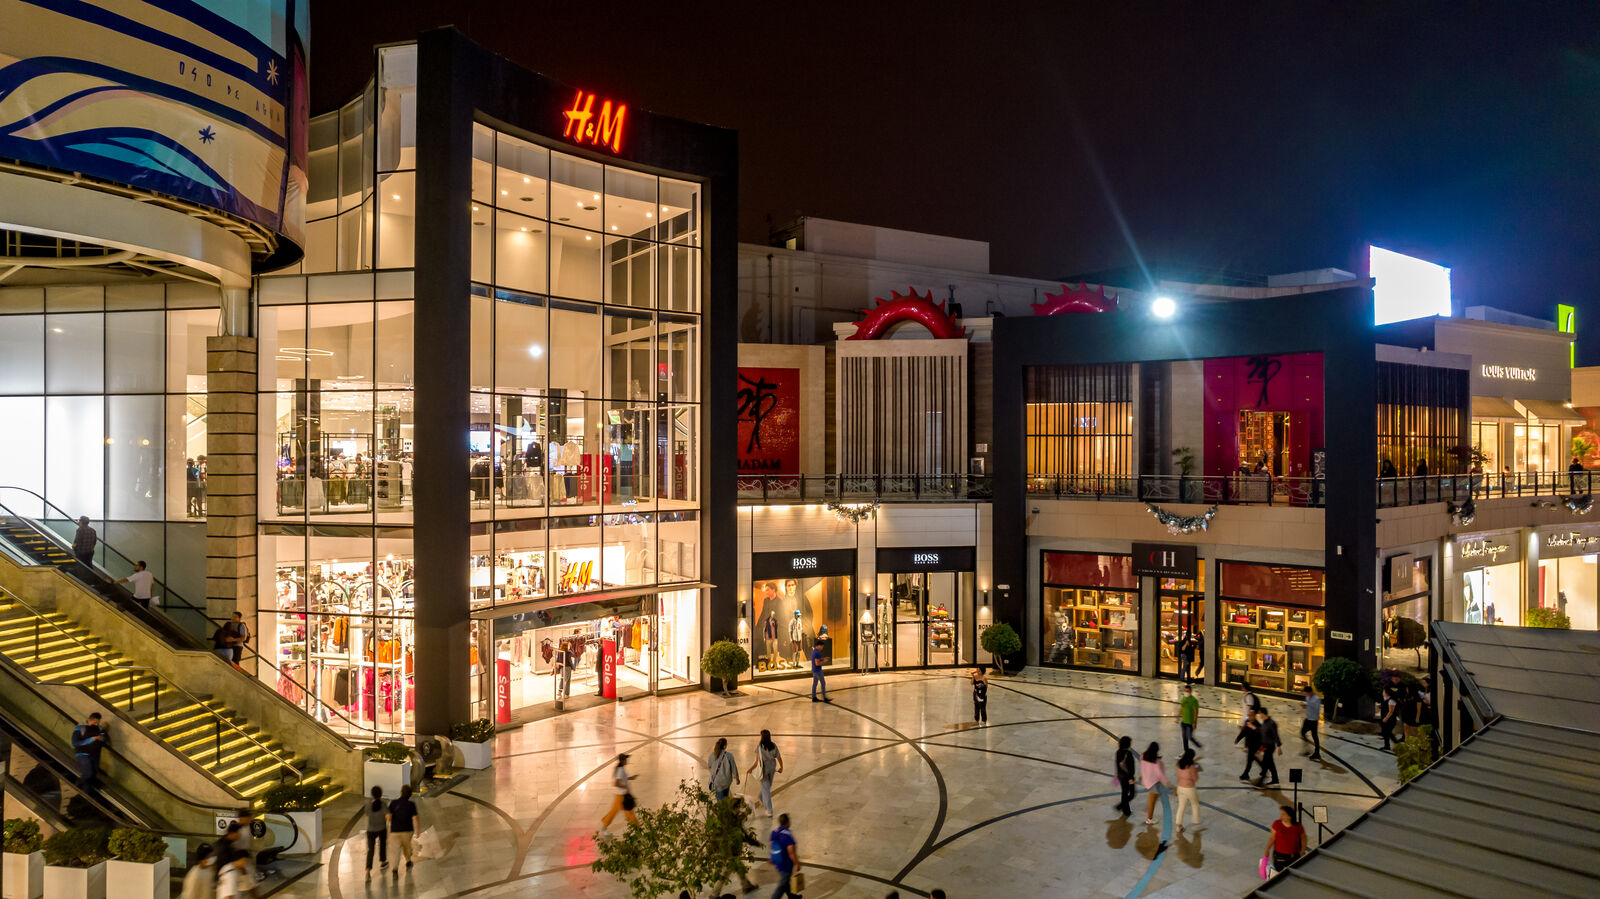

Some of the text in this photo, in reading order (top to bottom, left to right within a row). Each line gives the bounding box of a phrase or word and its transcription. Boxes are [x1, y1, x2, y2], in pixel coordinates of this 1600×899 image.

[562, 89, 627, 153] H&M
[1482, 364, 1536, 381] LOUIS VUITTON
[793, 557, 817, 566] BOSS
[914, 553, 939, 561] BOSS
[562, 560, 593, 589] H&M
[604, 654, 613, 684] Sale
[758, 660, 794, 672] BOSS
[498, 675, 508, 708] Sale
